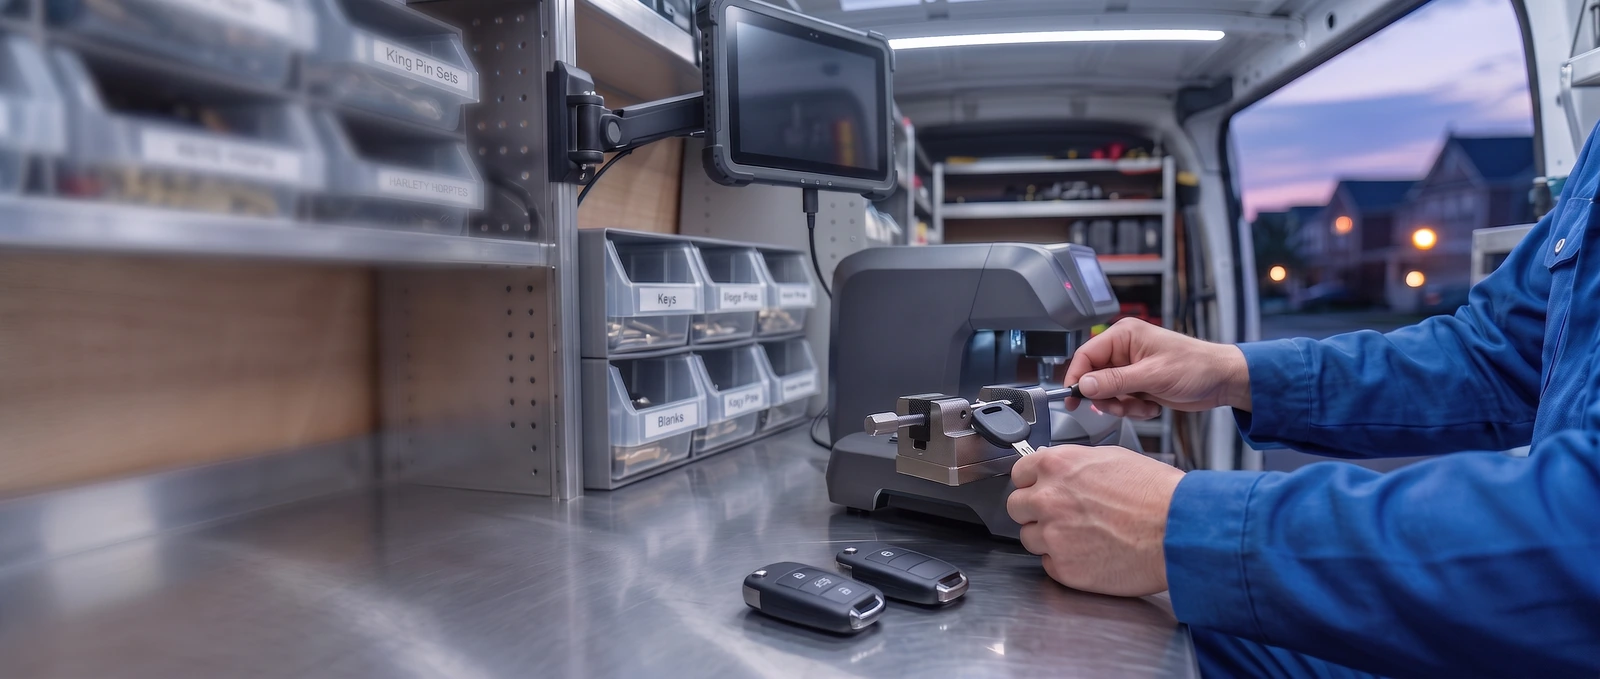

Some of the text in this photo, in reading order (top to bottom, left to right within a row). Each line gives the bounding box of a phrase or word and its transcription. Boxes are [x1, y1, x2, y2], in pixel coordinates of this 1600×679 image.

[386, 47, 459, 84] King Pin Sets
[657, 293, 677, 307] Keys
[658, 413, 684, 428] Blanks
